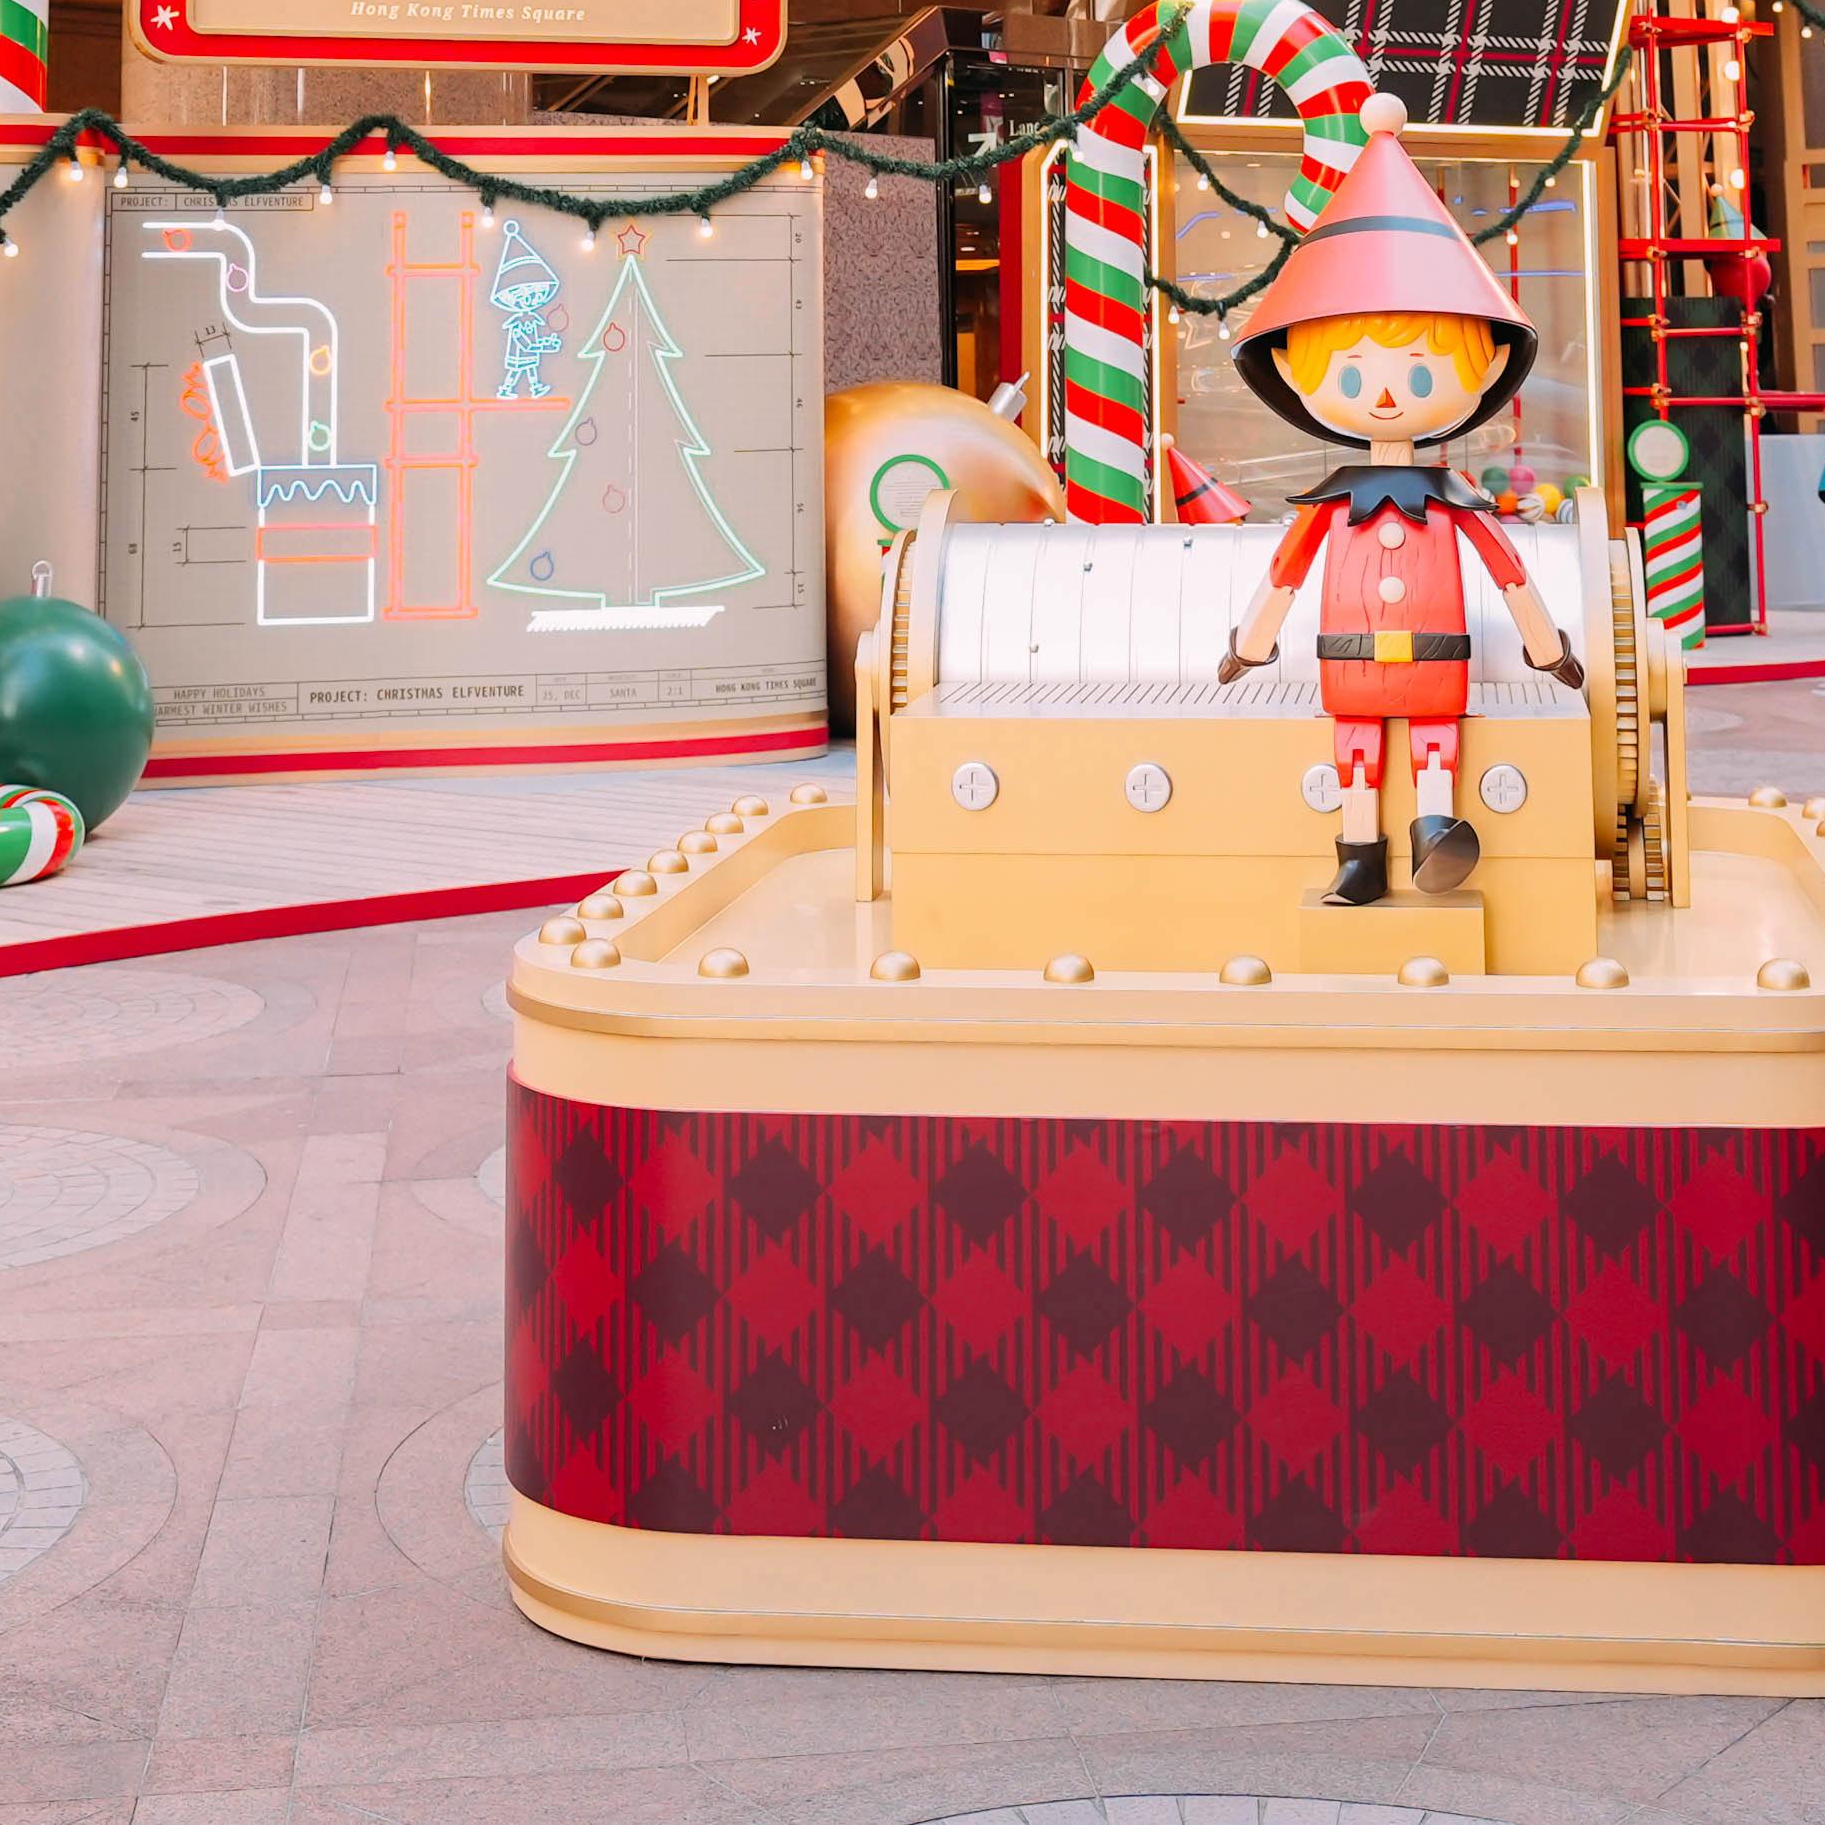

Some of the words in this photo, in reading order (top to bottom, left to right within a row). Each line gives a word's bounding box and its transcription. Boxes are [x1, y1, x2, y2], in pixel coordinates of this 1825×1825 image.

[350, 0, 399, 21] Hong
[406, 1, 455, 23] Kong
[462, 3, 515, 21] Times
[521, 5, 586, 25] Square
[120, 196, 169, 207] PROJECT:
[244, 196, 304, 207] ELFVENTURE
[715, 681, 736, 693] HONG
[741, 681, 761, 692] KONG
[766, 680, 789, 691] TIMES
[793, 677, 817, 690] SQUARE
[173, 688, 208, 700] HAPPY
[213, 686, 265, 699] HOLIDAYS
[309, 689, 368, 704] PROJECT:
[377, 686, 444, 701] CHRISTMAS
[452, 684, 525, 699] ELFVENTURE
[564, 688, 581, 700] DEC
[609, 686, 638, 699] SANTA
[202, 703, 243, 715] WINTER
[248, 701, 287, 714] WISHES
